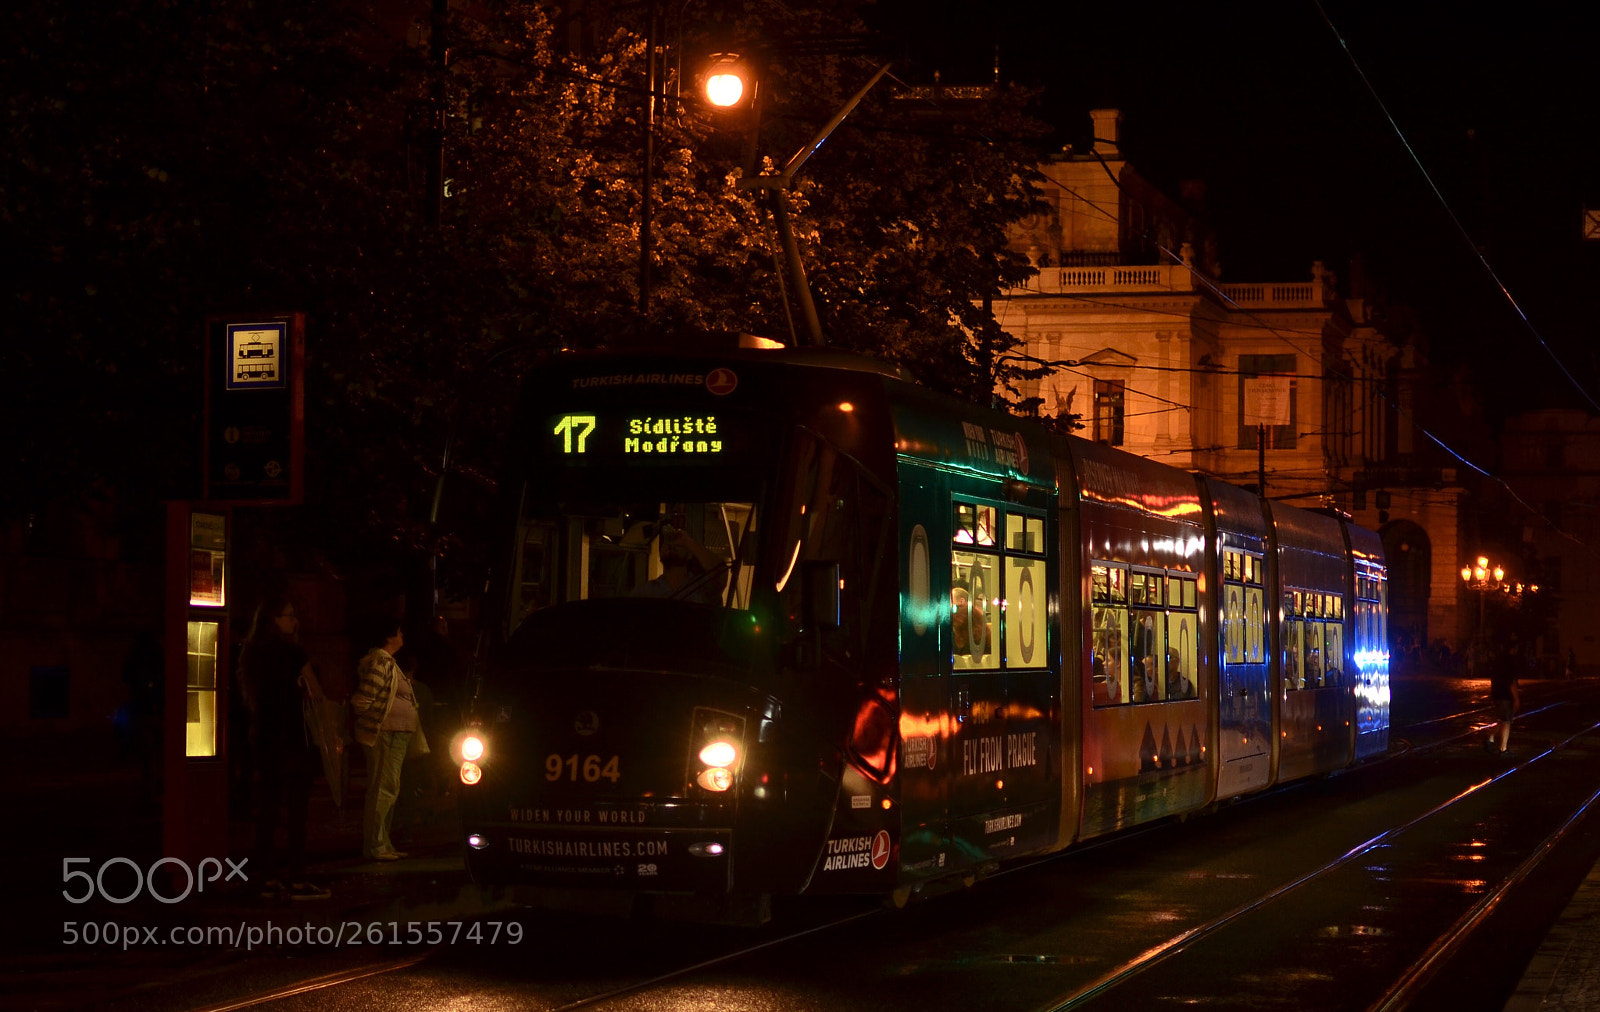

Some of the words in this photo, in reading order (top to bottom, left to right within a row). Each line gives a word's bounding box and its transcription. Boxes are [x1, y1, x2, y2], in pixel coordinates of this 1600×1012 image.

[570, 374, 632, 389] TURKISH
[634, 373, 703, 385] AIRLINES
[554, 415, 597, 454] 17
[628, 416, 718, 435] Sídliště
[623, 435, 723, 454] Modřany
[963, 738, 978, 776] FLY
[980, 735, 1003, 774] FROM
[1008, 731, 1036, 769] PRAGUE
[544, 753, 621, 783] 9164
[510, 808, 550, 822] WIDEN
[556, 809, 591, 823] YOUR
[598, 810, 646, 823] WORLD
[508, 837, 668, 857] TURKISHAIRLINES.COM
[828, 836, 872, 854] TURKISH
[637, 863, 657, 872] 20
[824, 853, 870, 871] AIRLINES
